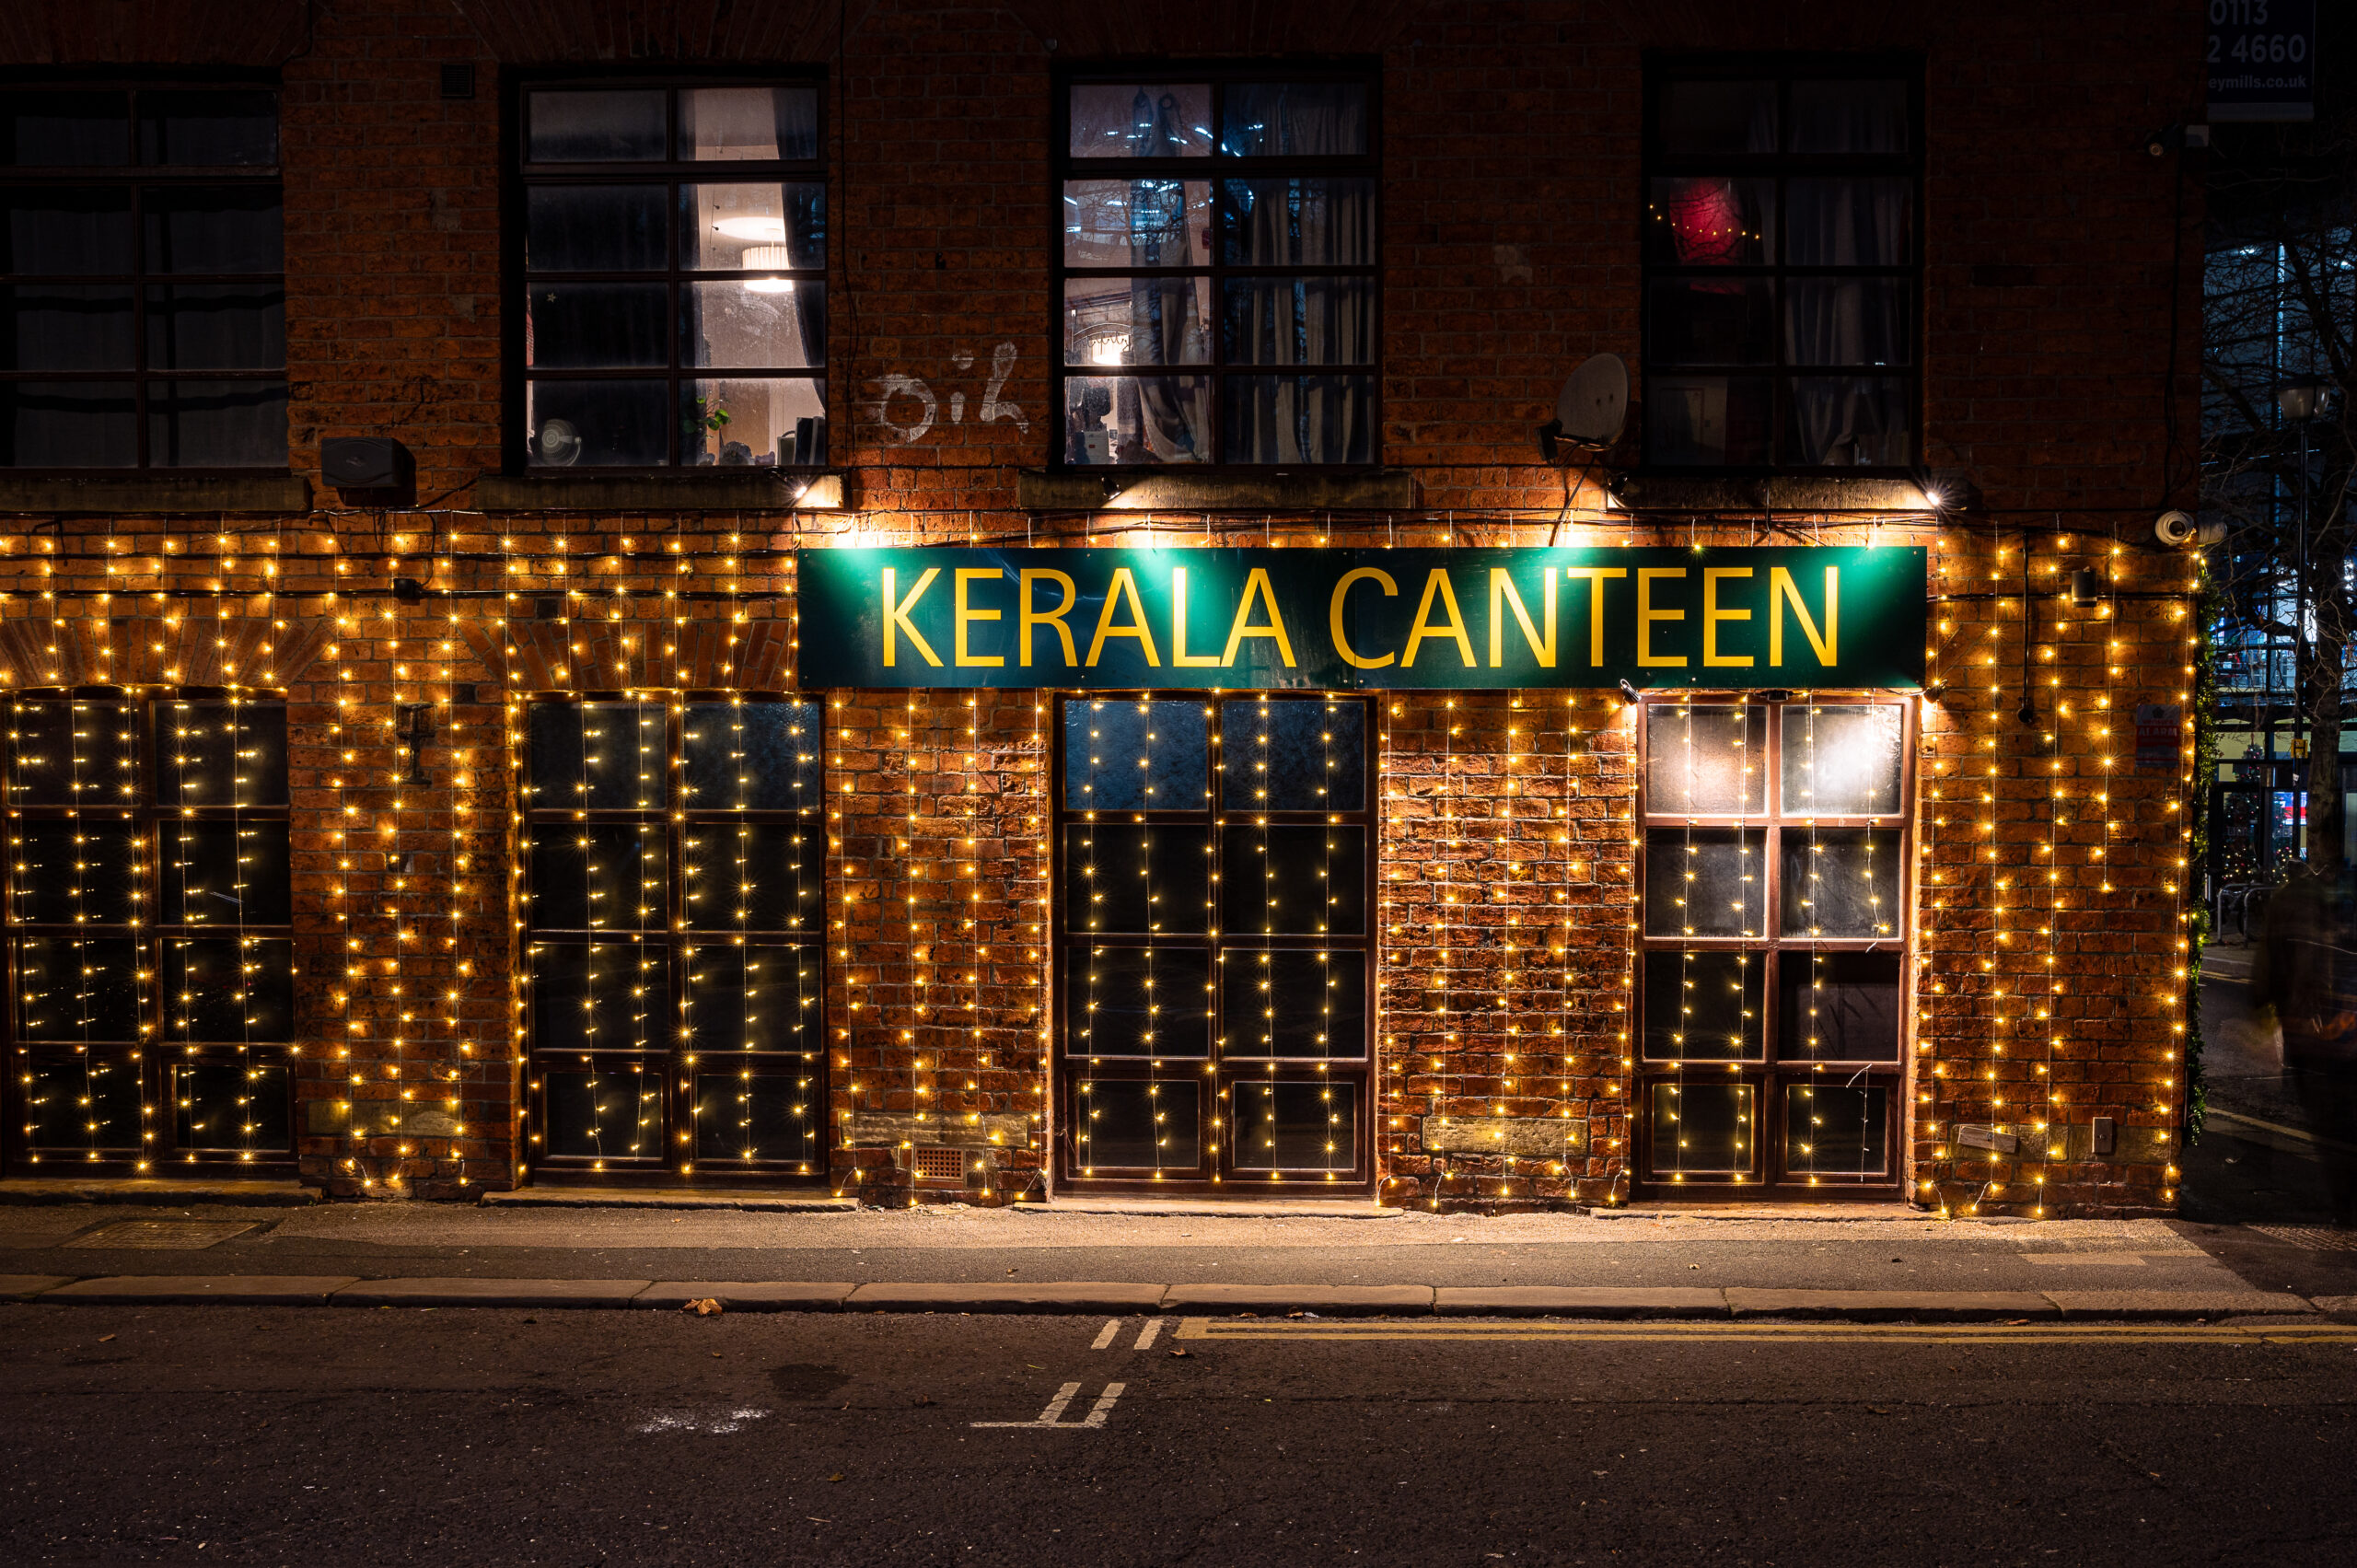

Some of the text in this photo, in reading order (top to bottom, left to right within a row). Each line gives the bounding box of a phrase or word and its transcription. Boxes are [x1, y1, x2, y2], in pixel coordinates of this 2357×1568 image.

[2211, 0, 2268, 25] 0113
[2232, 34, 2306, 63] 4660
[2209, 75, 2306, 92] eymills.co.uk
[881, 566, 1840, 668] KERALA CANTEEN
[2138, 726, 2178, 737] ALARM
